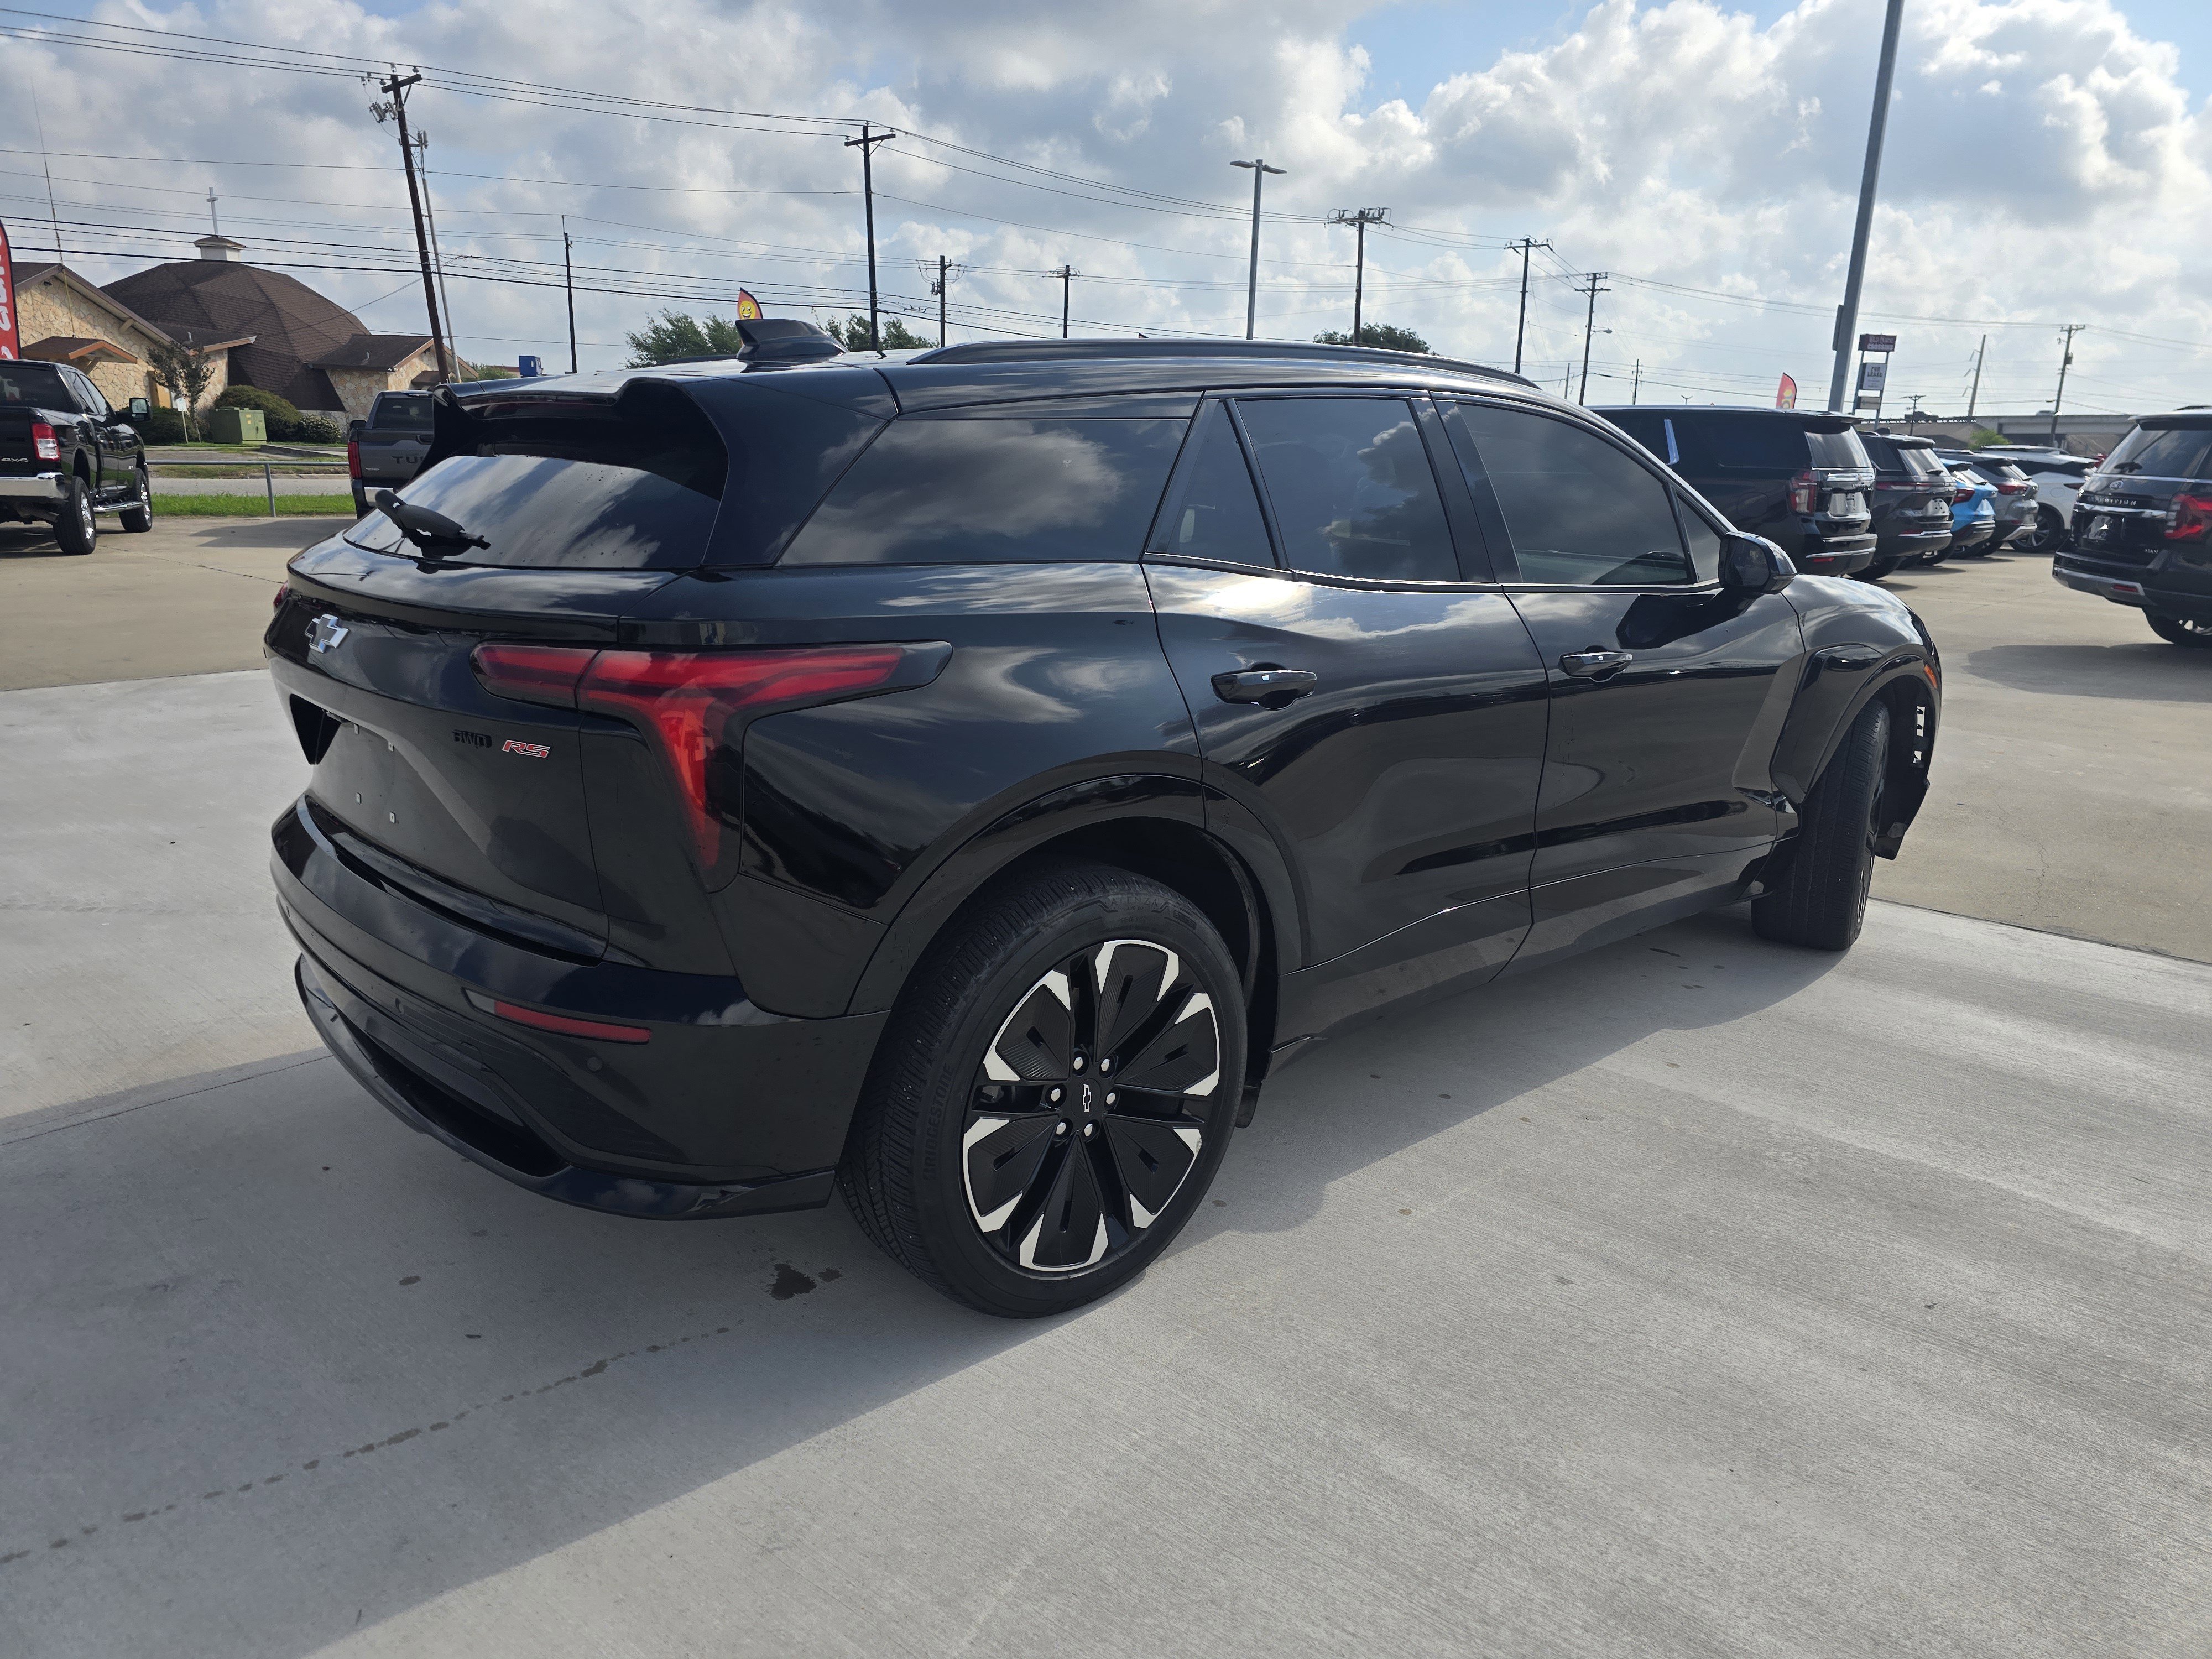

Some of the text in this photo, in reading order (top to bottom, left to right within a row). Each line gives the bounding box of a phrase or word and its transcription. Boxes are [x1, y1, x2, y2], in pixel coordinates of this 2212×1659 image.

[391, 456, 424, 464] TU
[502, 740, 551, 758] RS
[1111, 896, 1158, 907] ALENZA
[922, 1063, 954, 1181] BRIDGESTONE
